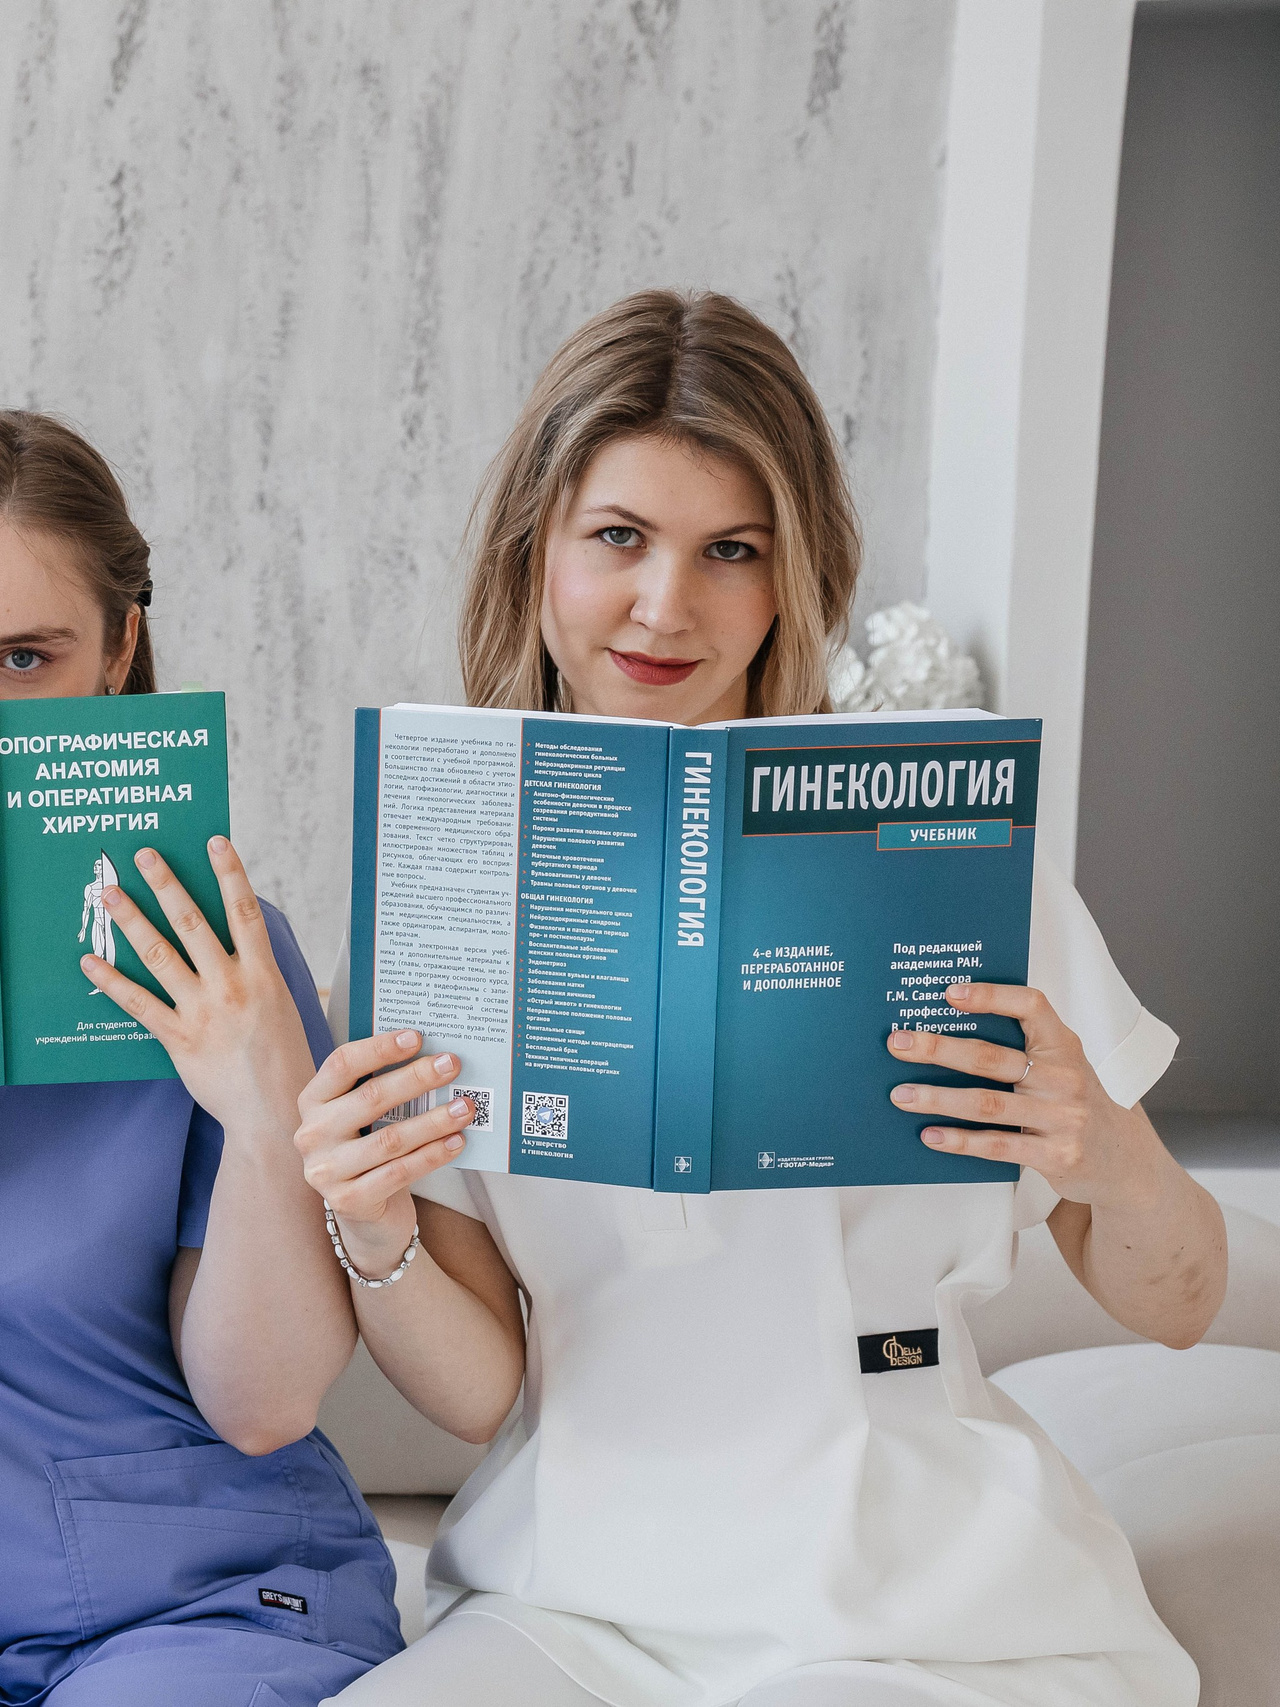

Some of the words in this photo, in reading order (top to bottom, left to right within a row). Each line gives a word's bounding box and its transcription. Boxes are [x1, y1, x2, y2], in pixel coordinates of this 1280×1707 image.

[395, 734, 428, 743] Четвертое
[461, 738, 492, 747] учебника
[423, 745, 469, 756] переработано
[480, 750, 517, 759] дополнено
[535, 742, 559, 751] Методы
[560, 743, 603, 753] обследования
[391, 755, 435, 763] соответствии
[443, 756, 471, 766] учебной
[473, 758, 516, 768] программой.
[535, 752, 590, 760] гинекологических
[591, 753, 618, 761] больных
[35, 757, 159, 780] АНАТОМИЯ
[385, 763, 428, 772] Большинство
[447, 767, 483, 776] обновлено
[535, 760, 593, 771] Нейроэндокринная
[594, 765, 626, 773] регуляция
[384, 774, 419, 782] последних
[421, 775, 461, 785] достижений
[469, 778, 496, 786] области
[534, 770, 583, 778] менструального
[584, 772, 602, 780] цикла
[384, 784, 404, 792] логии,
[407, 784, 463, 795] патофизиологии,
[466, 789, 508, 798] диагностики
[524, 780, 553, 788] ДЕТСКАЯ
[554, 782, 602, 790] ГИНЕКОЛОГИЯ
[751, 758, 1016, 813] ГИНЕКОЛОГИЯ
[7, 792, 21, 809] И
[28, 784, 192, 808] ОПЕРАТИВНАЯ
[534, 790, 615, 803] Анатомо-физиологические
[533, 798, 571, 807] особенности
[572, 802, 598, 810] девочки
[604, 804, 632, 812] процессе
[533, 808, 568, 816] созревания
[569, 809, 619, 819] репродуктивной
[42, 812, 159, 834] ХИРУРГИЯ
[533, 824, 555, 833] Пороки
[556, 827, 584, 835] развития
[613, 831, 637, 839] органов
[910, 826, 977, 842] УЧЕБНИК
[532, 834, 567, 844] Нарушения
[597, 840, 625, 848] развития
[677, 752, 712, 947] ГИНЕКОЛОГИЯ
[532, 852, 561, 860] Маточные
[562, 855, 605, 864] кровотечения
[531, 859, 571, 870] пубертатного
[572, 864, 598, 872] периода
[531, 870, 581, 881] Вульвовагиниты
[586, 875, 612, 883] девочек
[531, 879, 553, 888] Травмы
[582, 884, 606, 892] органов
[521, 893, 545, 901] ОБЩАЯ
[546, 895, 594, 904] ГИНЕКОЛОГИЯ
[753, 948, 772, 959] 4-е
[775, 945, 834, 960] ИЗДАНИЕ,
[893, 943, 915, 954] Под
[919, 940, 982, 955] редакцией
[741, 961, 845, 975] ПЕРЕРАБОТАННОЕ
[891, 960, 953, 971] академика
[957, 957, 983, 969] РАН,
[743, 980, 751, 991] И
[754, 977, 842, 992] ДОПОЛНЕННОЕ
[901, 974, 971, 987] профессора
[886, 991, 908, 1001] Г.М.
[912, 990, 946, 1001] Савел
[77, 1021, 93, 1031] Для
[95, 1021, 137, 1030] студентов
[915, 1022, 977, 1034] Бреусенко
[35, 1034, 87, 1045] учреждений
[89, 1033, 126, 1042] высшего
[522, 1138, 567, 1148] Акушерство
[528, 1149, 573, 1159] гинекология
[890, 1355, 923, 1366] DESIGN
